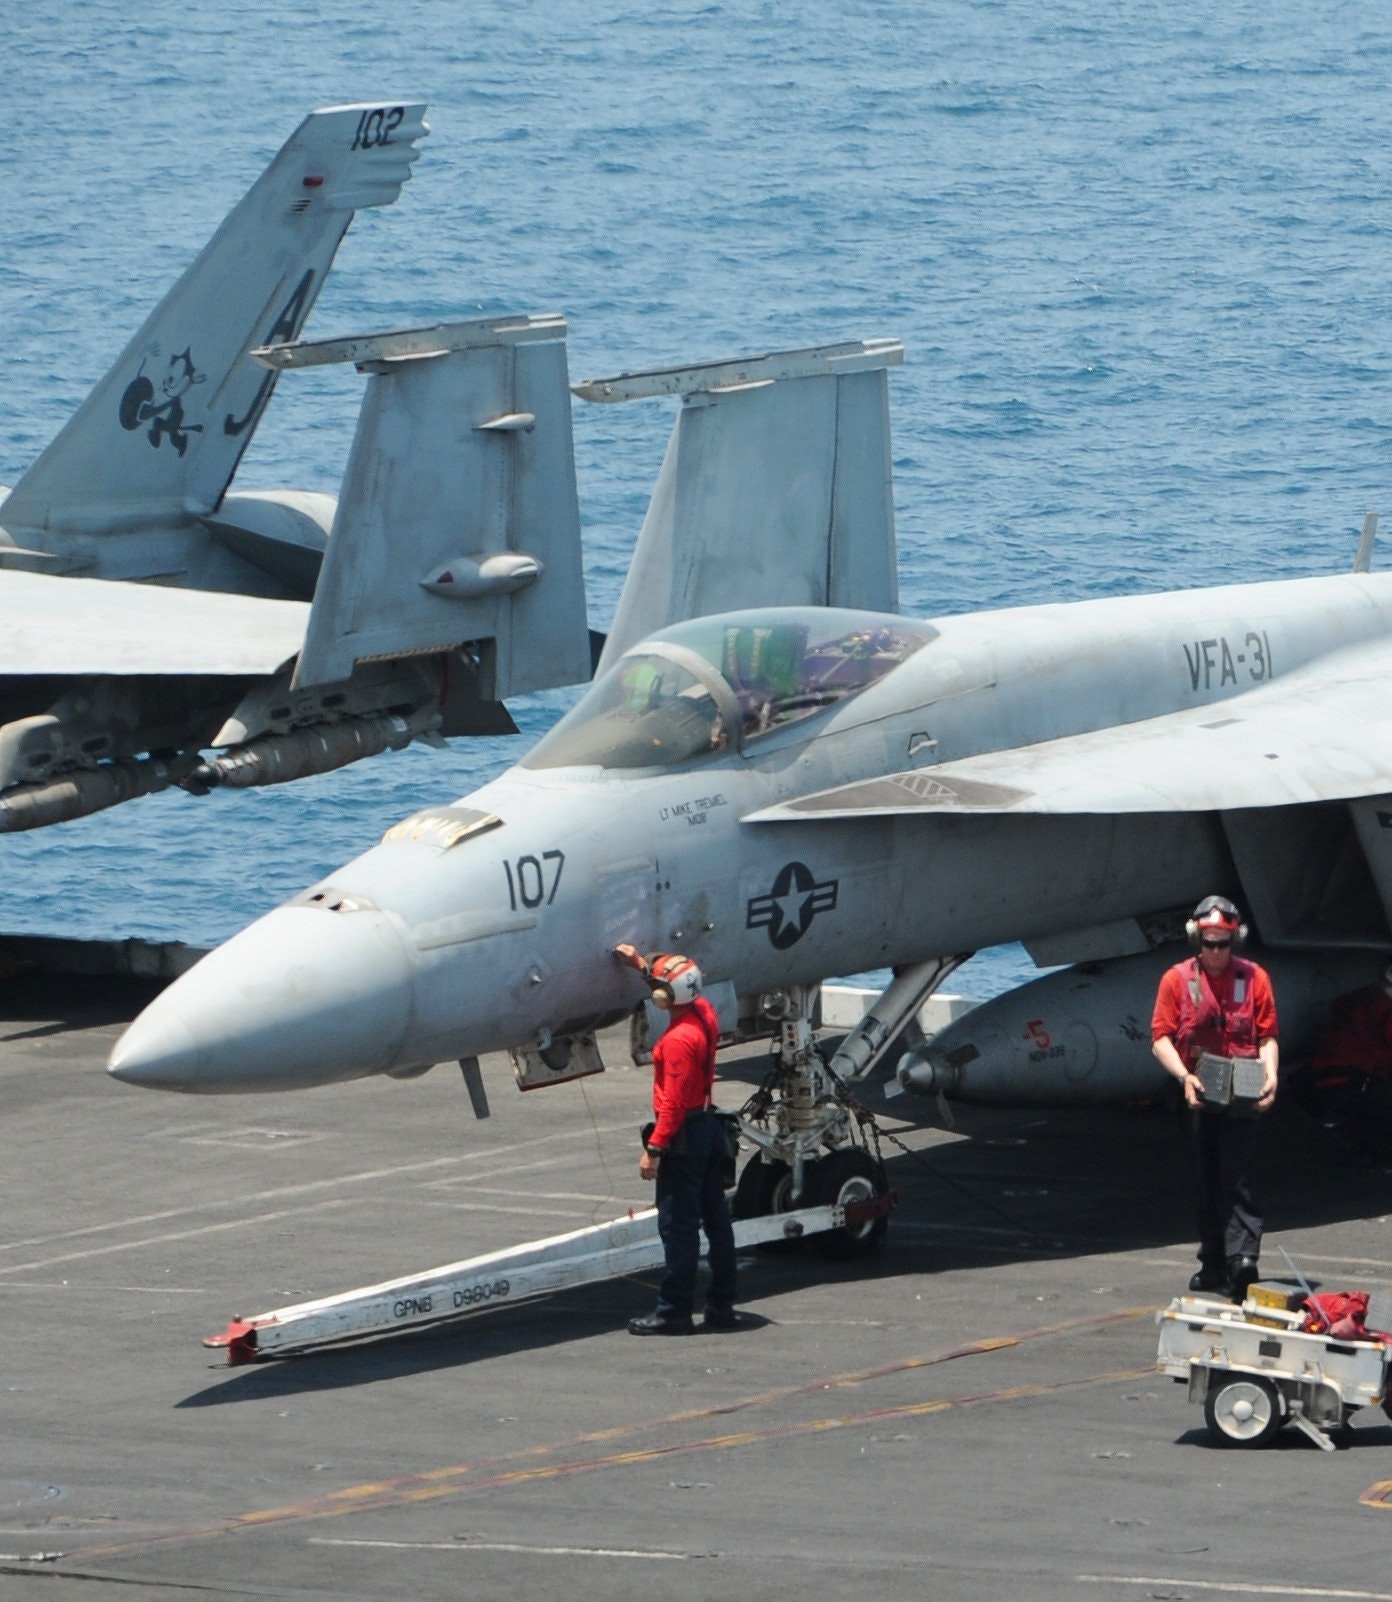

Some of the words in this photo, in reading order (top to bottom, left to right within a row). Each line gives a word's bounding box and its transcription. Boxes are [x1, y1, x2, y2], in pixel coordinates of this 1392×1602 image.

[350, 106, 405, 151] 102
[1182, 629, 1273, 692] VFA-31
[502, 849, 566, 912] 107
